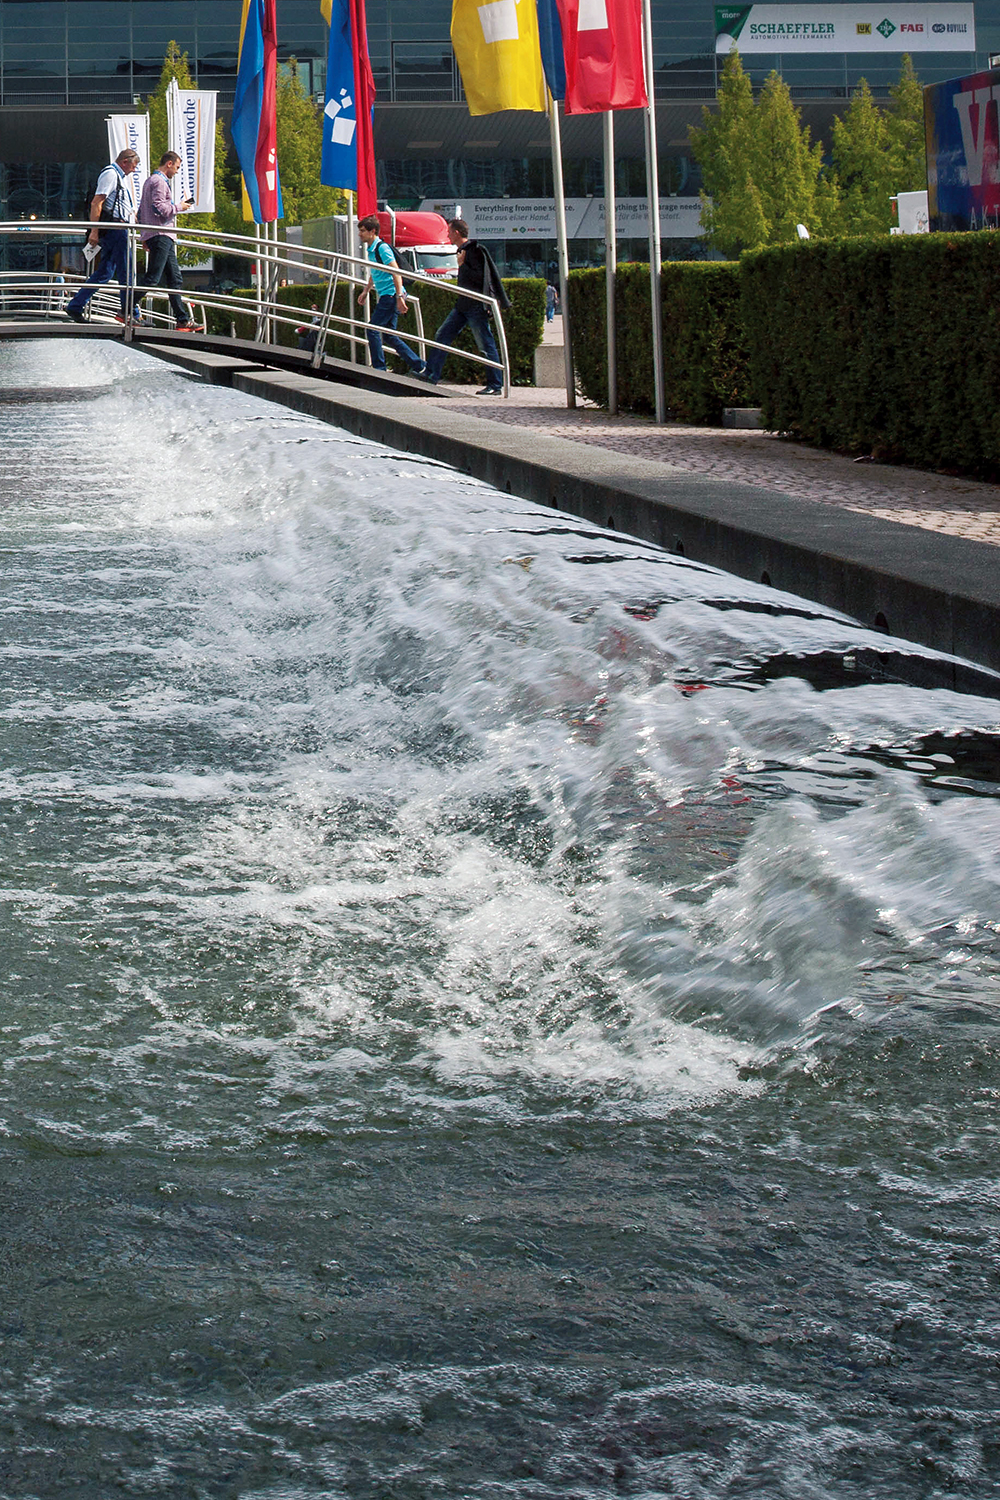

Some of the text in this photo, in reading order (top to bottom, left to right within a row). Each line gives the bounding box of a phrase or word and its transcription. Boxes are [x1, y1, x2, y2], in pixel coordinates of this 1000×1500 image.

[750, 23, 835, 34] SCHAEFFLER
[900, 23, 924, 32] FAG
[474, 205, 513, 213] Everything
[515, 204, 532, 212] from
